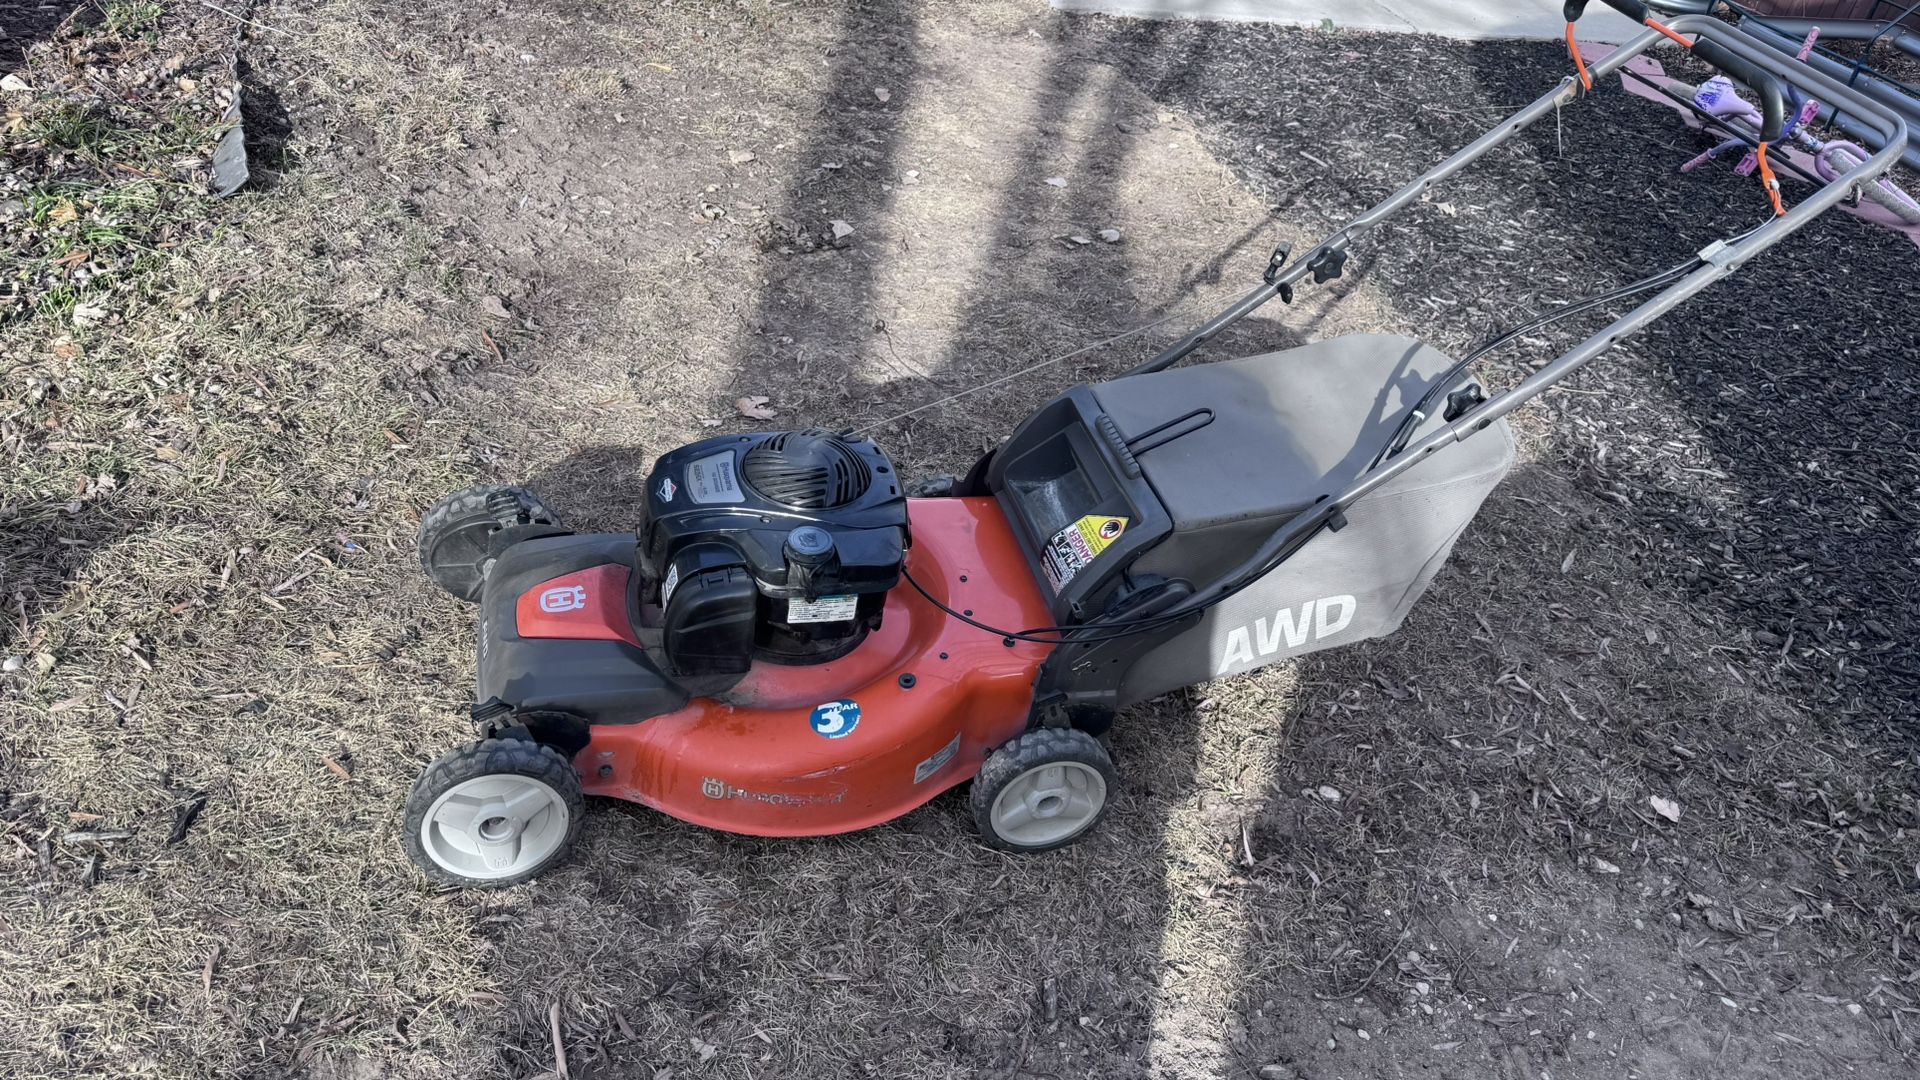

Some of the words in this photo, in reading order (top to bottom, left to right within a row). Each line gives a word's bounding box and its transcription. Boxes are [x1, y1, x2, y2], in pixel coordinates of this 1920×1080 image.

[1216, 595, 1357, 676] AWD
[817, 702, 845, 734] 3
[829, 703, 859, 714] YEAR
